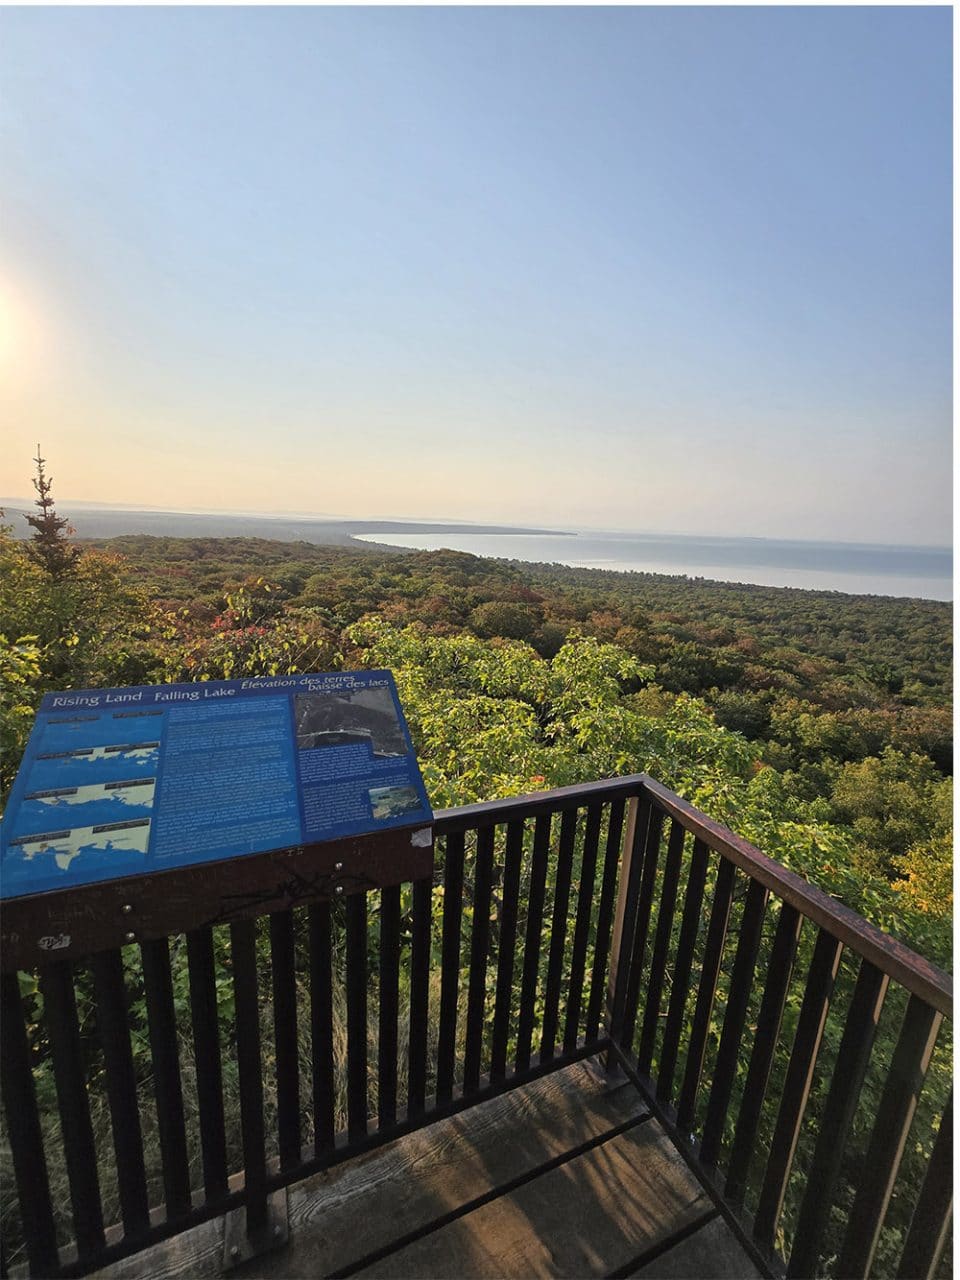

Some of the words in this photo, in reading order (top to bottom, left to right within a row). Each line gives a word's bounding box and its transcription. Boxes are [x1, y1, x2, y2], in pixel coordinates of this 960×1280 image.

[241, 679, 296, 690] Élévation
[299, 677, 321, 685] des
[324, 675, 355, 683] terres
[308, 683, 344, 692] baisse
[345, 681, 366, 689] des
[368, 679, 389, 687] lacs
[52, 696, 99, 708] Rising
[105, 691, 143, 703] Land
[154, 690, 200, 702] Falling
[204, 687, 236, 698] Lake
